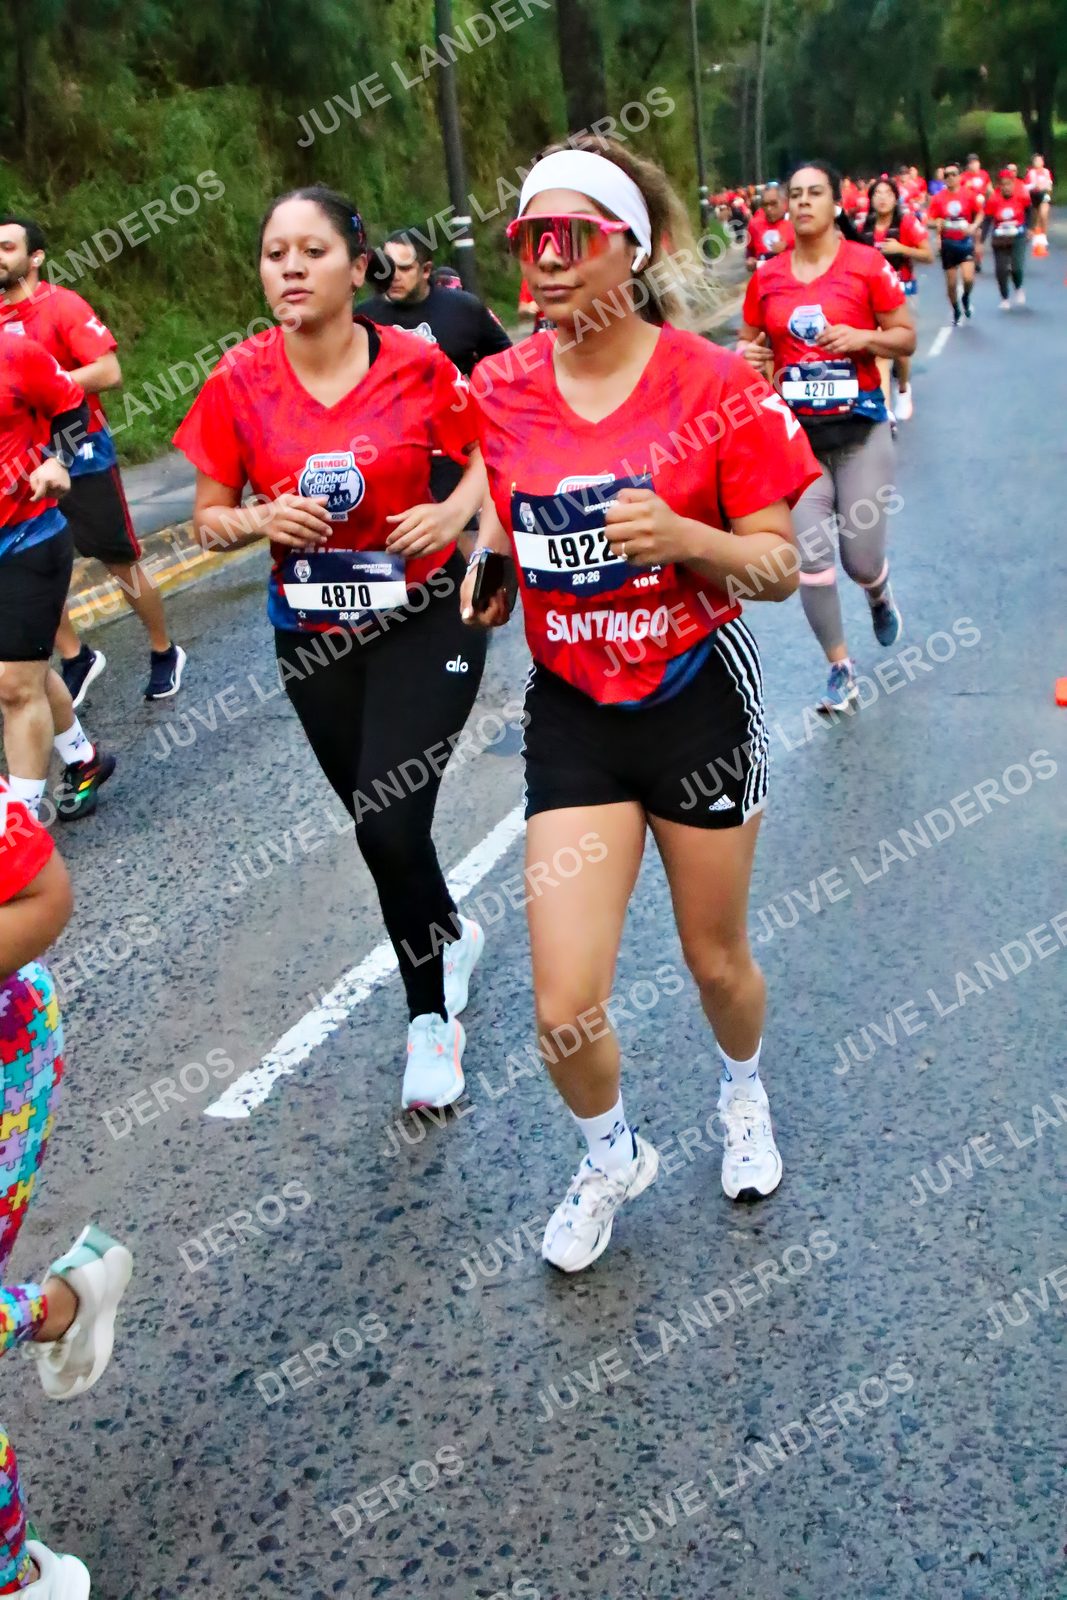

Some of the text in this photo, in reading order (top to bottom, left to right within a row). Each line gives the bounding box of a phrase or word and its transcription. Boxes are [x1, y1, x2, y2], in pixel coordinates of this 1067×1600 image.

[805, 382, 834, 396] 4270
[313, 460, 348, 468] BIMBO
[314, 471, 348, 484] Global
[309, 483, 336, 494] Race
[548, 531, 618, 568] 4922
[632, 574, 659, 588] 10K
[321, 585, 372, 607] 4870
[546, 605, 669, 645] SANTIAGO
[446, 655, 468, 672] alo
